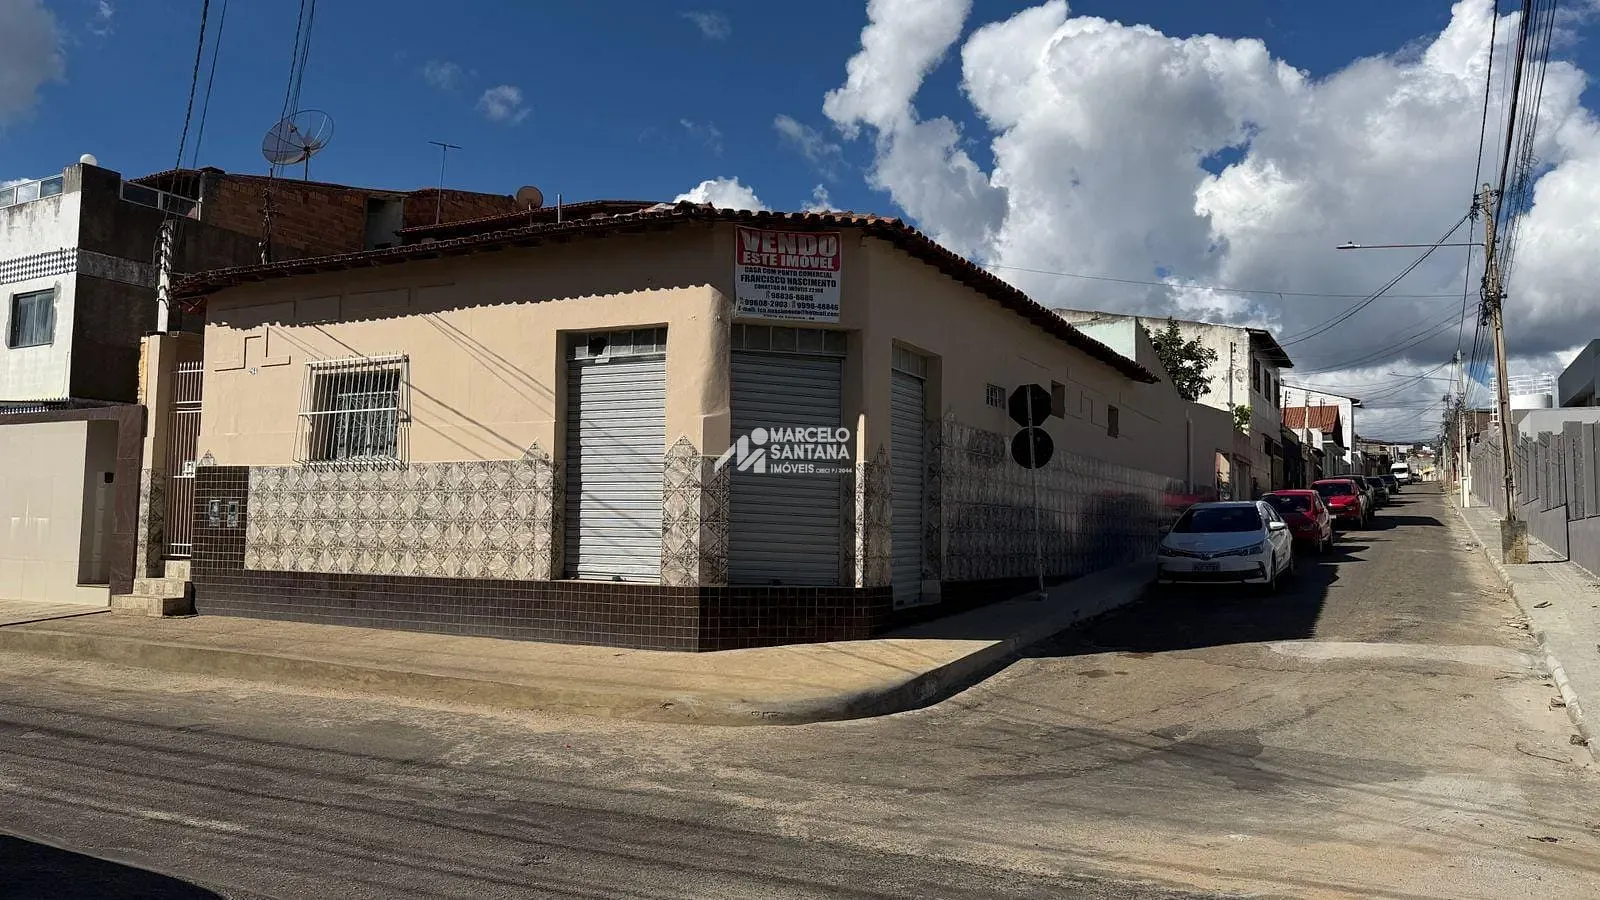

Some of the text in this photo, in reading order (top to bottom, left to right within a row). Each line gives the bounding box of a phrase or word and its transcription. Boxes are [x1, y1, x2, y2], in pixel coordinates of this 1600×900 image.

[741, 229, 837, 257] VENDO
[743, 251, 778, 266] ESTE
[740, 274, 837, 288] FRANCISCO NASCIMENTO
[778, 269, 797, 277] PONTO
[798, 270, 833, 279] COMERCIAL
